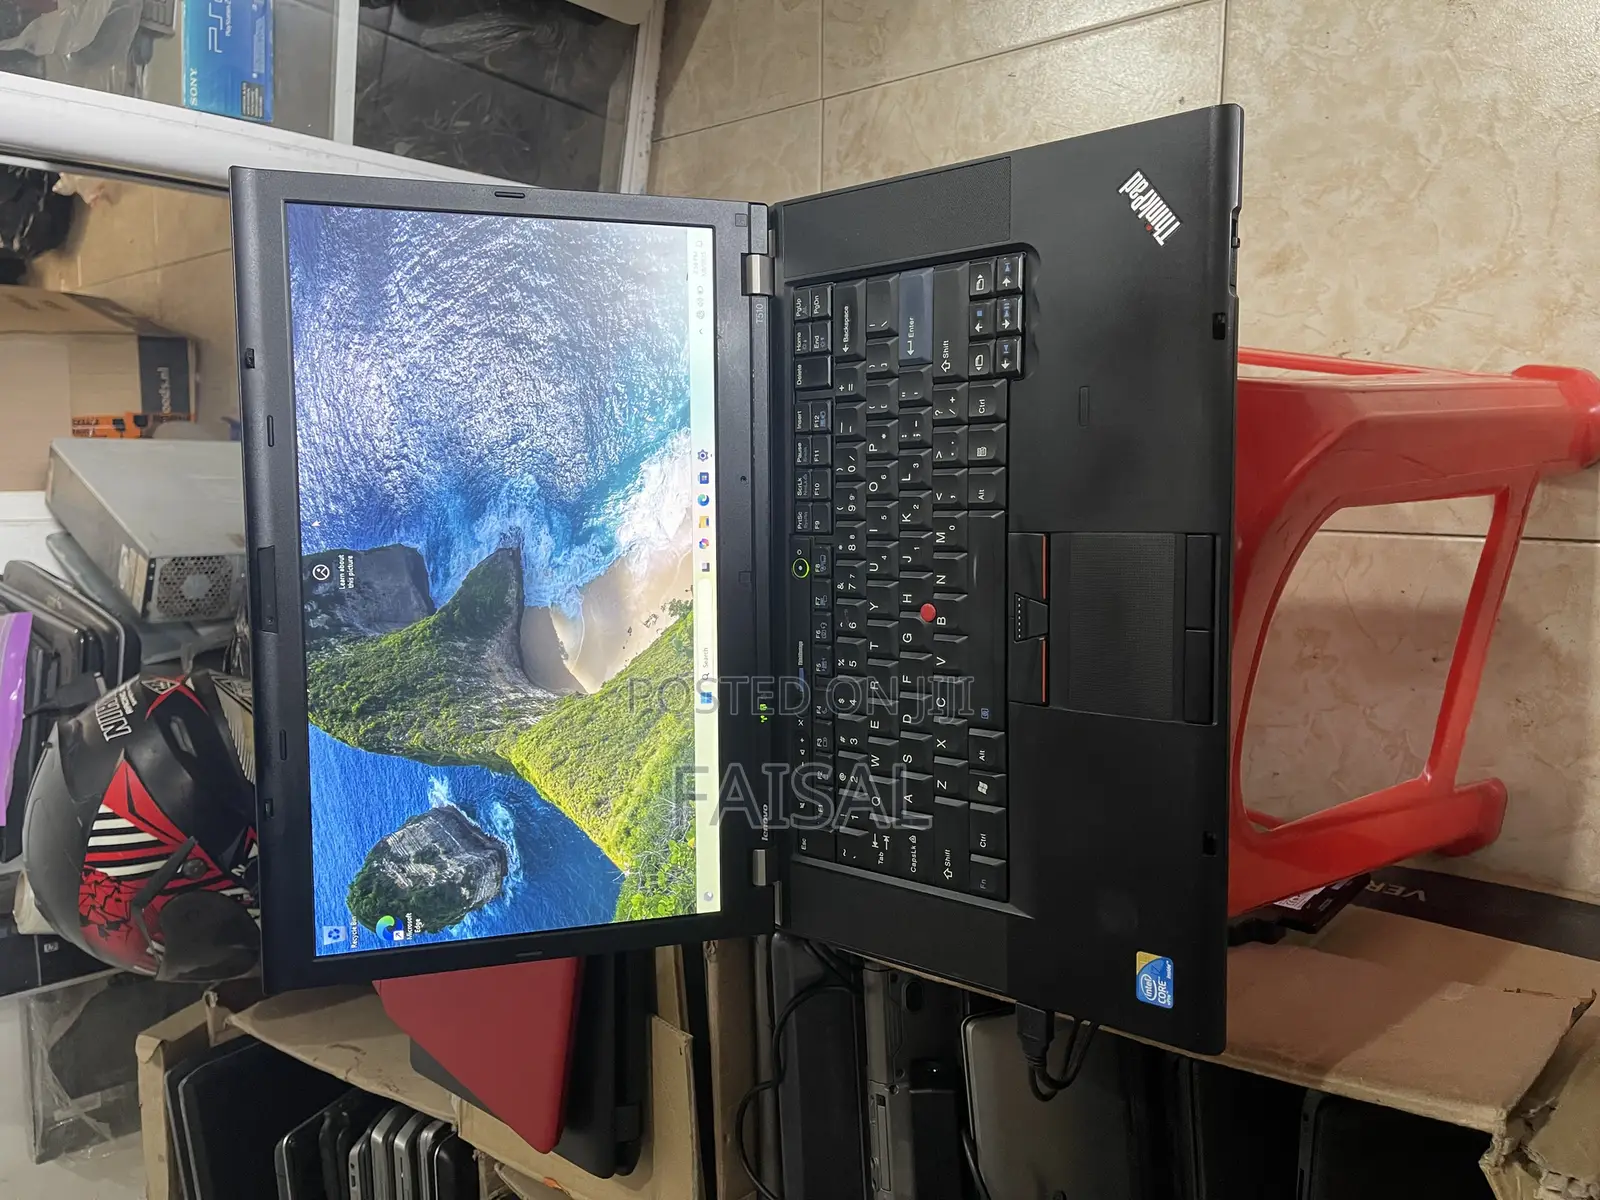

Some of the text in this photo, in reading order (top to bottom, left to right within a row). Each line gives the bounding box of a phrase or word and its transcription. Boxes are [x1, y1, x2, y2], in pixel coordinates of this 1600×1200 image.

[208, 0, 223, 53] PS
[190, 67, 198, 106] SONY
[1118, 171, 1181, 246] ThinkPad
[812, 295, 820, 314] PgDn
[755, 304, 764, 324] T510
[842, 306, 850, 343] Backspace
[907, 316, 915, 339] Enter
[941, 339, 950, 360] Shift
[978, 398, 986, 415] Ctrl
[934, 408, 944, 417] ?
[868, 442, 878, 452] P
[912, 462, 920, 470] 3
[902, 472, 911, 482] L
[978, 488, 986, 502] Alt
[848, 504, 856, 513] 9
[912, 503, 920, 511] 2
[880, 513, 887, 521] 5
[901, 512, 912, 523] K
[815, 520, 821, 530] F9
[935, 531, 946, 544] M
[848, 543, 857, 552] 8
[901, 554, 912, 564] J
[347, 556, 355, 588] this picture
[815, 563, 821, 573] F8
[868, 561, 879, 572] U
[338, 574, 346, 590] Learn
[936, 573, 946, 585] N
[837, 581, 845, 591] &
[848, 583, 857, 591] 7
[815, 596, 821, 606] F7
[901, 593, 912, 604] H
[868, 601, 879, 612] Y
[848, 621, 857, 630] 6
[936, 615, 947, 627] B
[815, 630, 822, 639] F6
[902, 632, 913, 644] G
[868, 640, 879, 651] T
[837, 658, 845, 667] %
[848, 659, 857, 668] 5
[936, 656, 947, 667] V
[902, 674, 912, 684] F
[869, 680, 879, 691] R
[849, 698, 857, 706] 4
[935, 696, 946, 709] C
[816, 705, 822, 715] F4
[869, 719, 880, 730] E
[902, 713, 912, 725] D
[816, 738, 823, 748] F3
[849, 737, 858, 746] 3
[936, 738, 947, 749] X
[869, 753, 880, 768] W
[902, 753, 913, 764] S
[978, 749, 986, 763] Alt
[850, 775, 859, 784] 2
[936, 779, 947, 791] Z
[870, 795, 882, 807] Q
[903, 793, 914, 804] A
[761, 804, 769, 842] lenovo
[979, 832, 987, 849] Ctrl
[877, 851, 885, 865] Tab
[909, 844, 918, 874] CapsLk
[943, 848, 951, 868] Shift
[979, 878, 987, 891] Fn
[1364, 880, 1427, 902] VER
[405, 912, 413, 940] Microsoft
[414, 918, 422, 933] Edge
[1144, 977, 1153, 997] intel
[1157, 980, 1167, 1005] CORE
